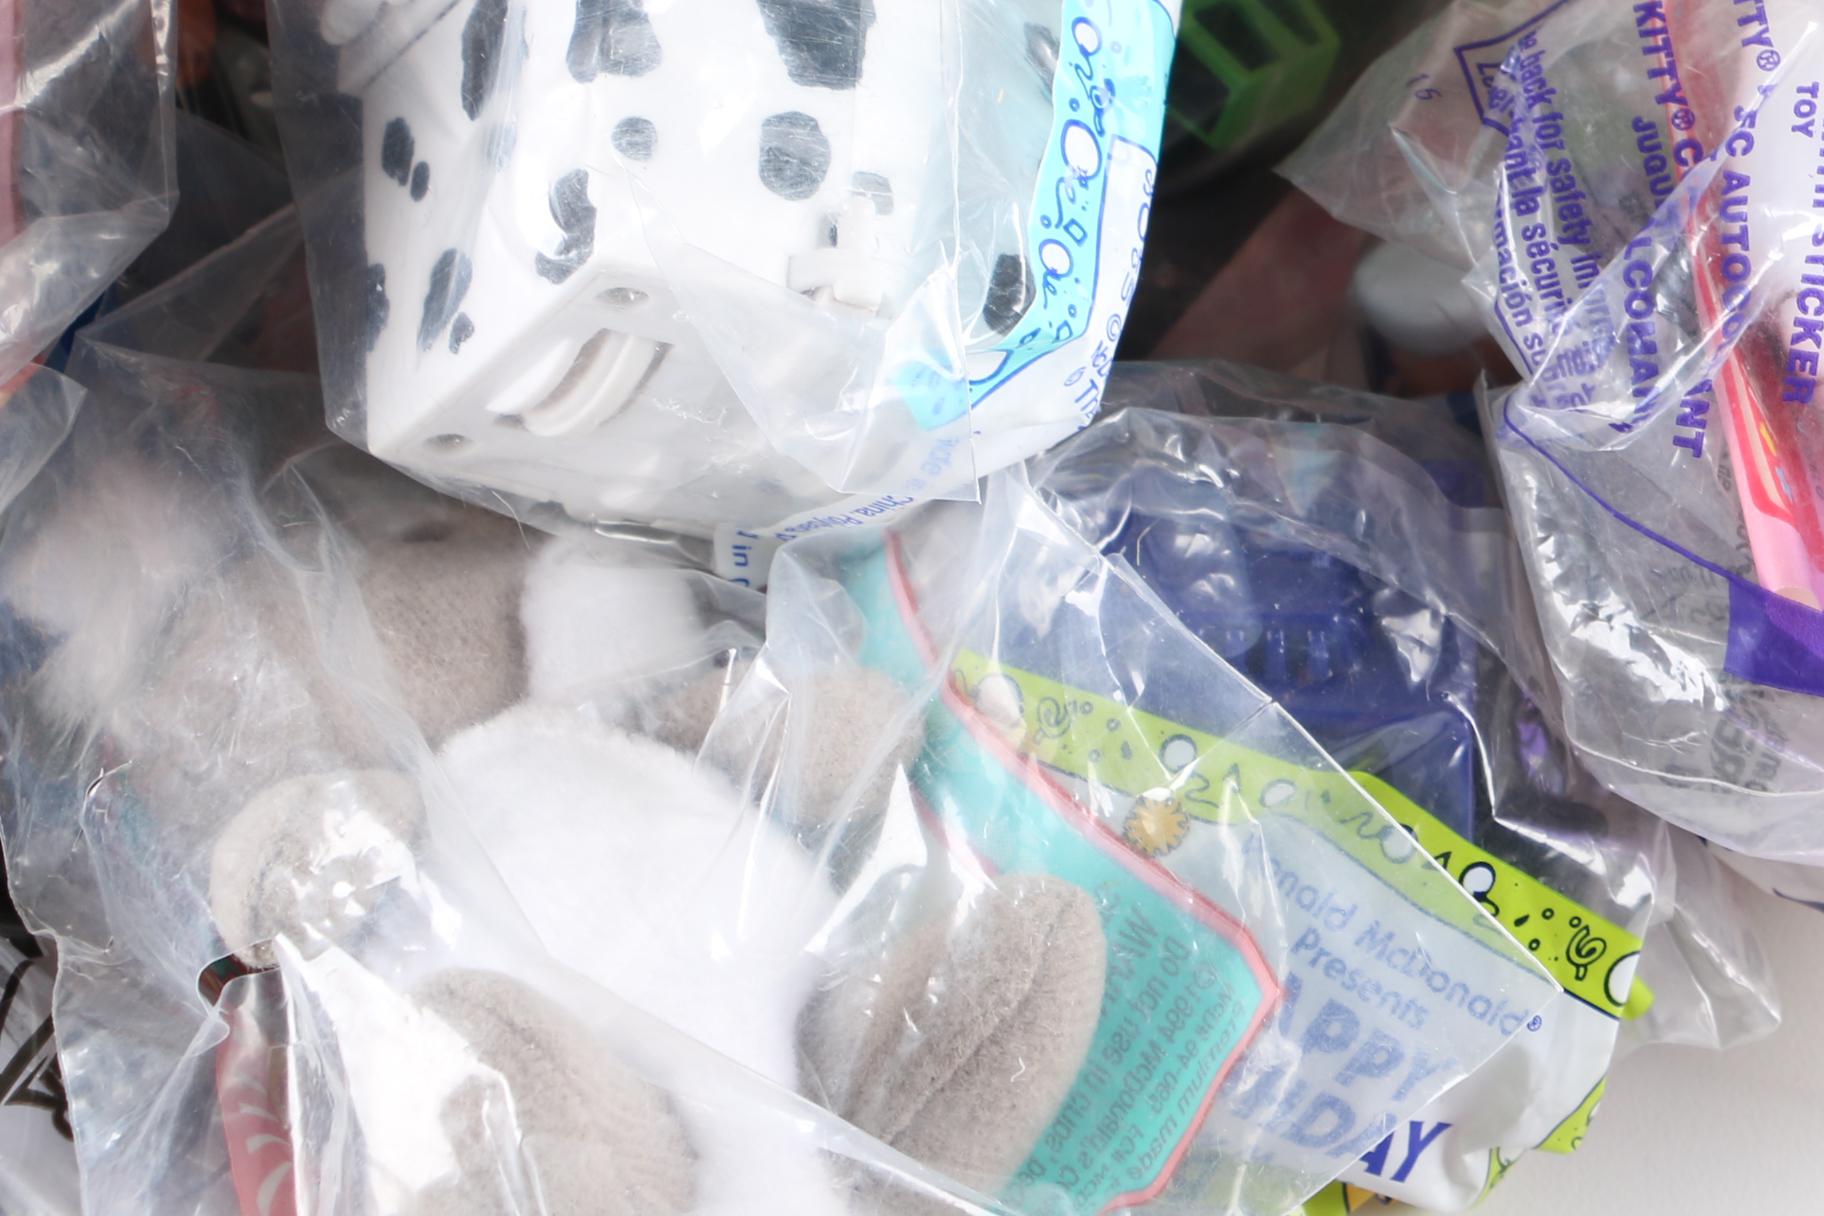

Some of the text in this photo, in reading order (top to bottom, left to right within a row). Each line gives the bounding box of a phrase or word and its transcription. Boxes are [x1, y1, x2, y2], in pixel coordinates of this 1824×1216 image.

[1531, 108, 1566, 154] for
[1789, 81, 1820, 139] TOY
[1511, 180, 1542, 219] la
[1544, 151, 1597, 249] safety
[1292, 927, 1433, 1033] Presents
